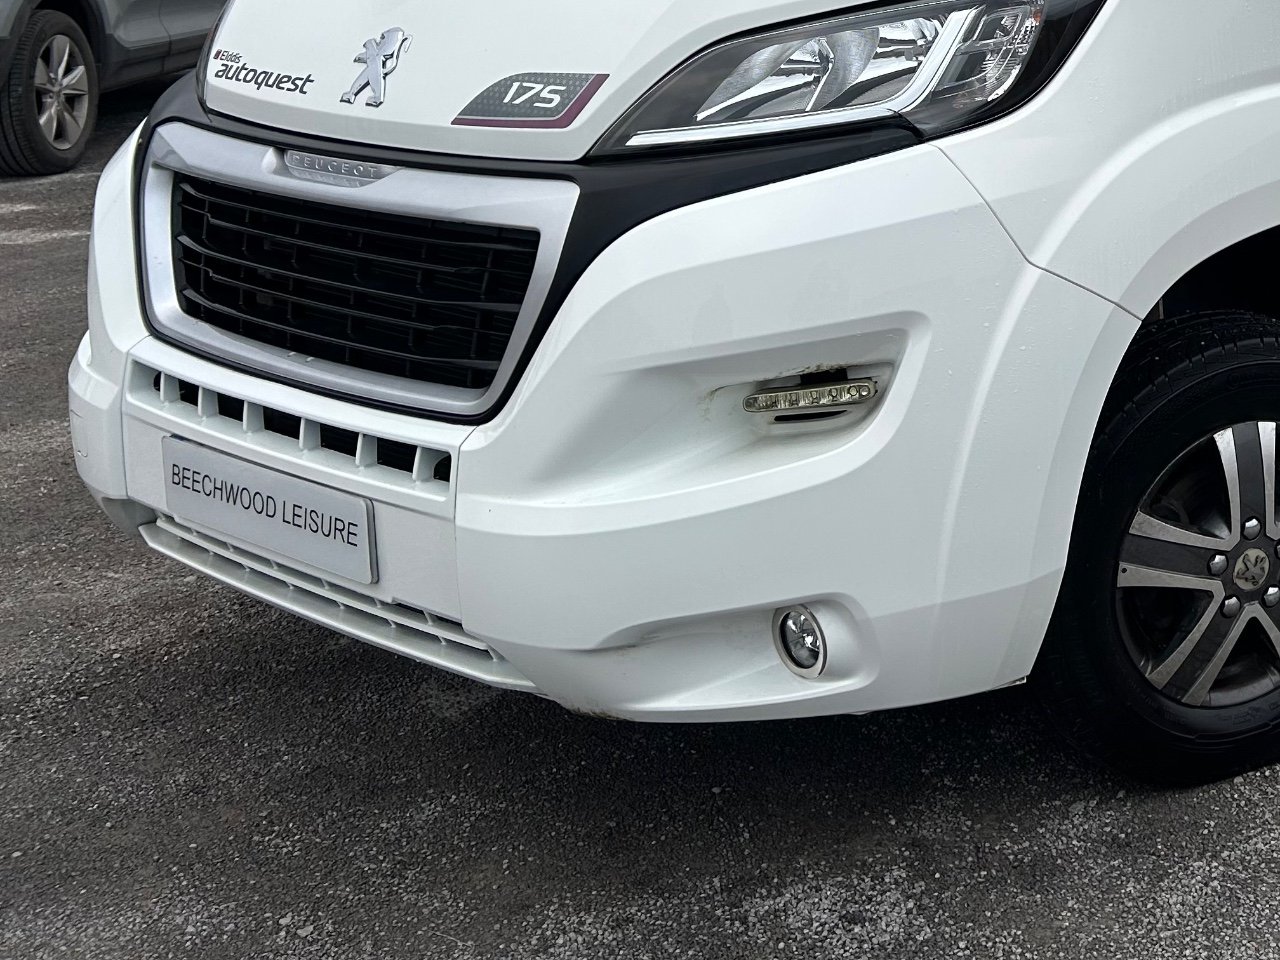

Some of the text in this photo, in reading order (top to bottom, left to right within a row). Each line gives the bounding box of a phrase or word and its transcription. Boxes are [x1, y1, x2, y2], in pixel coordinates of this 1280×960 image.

[220, 50, 242, 64] Elddis
[214, 62, 315, 95] autoquest
[502, 81, 567, 108] 175
[292, 153, 377, 178] PEUGEOT
[172, 463, 359, 547] BEECHWOOD LEISURE
